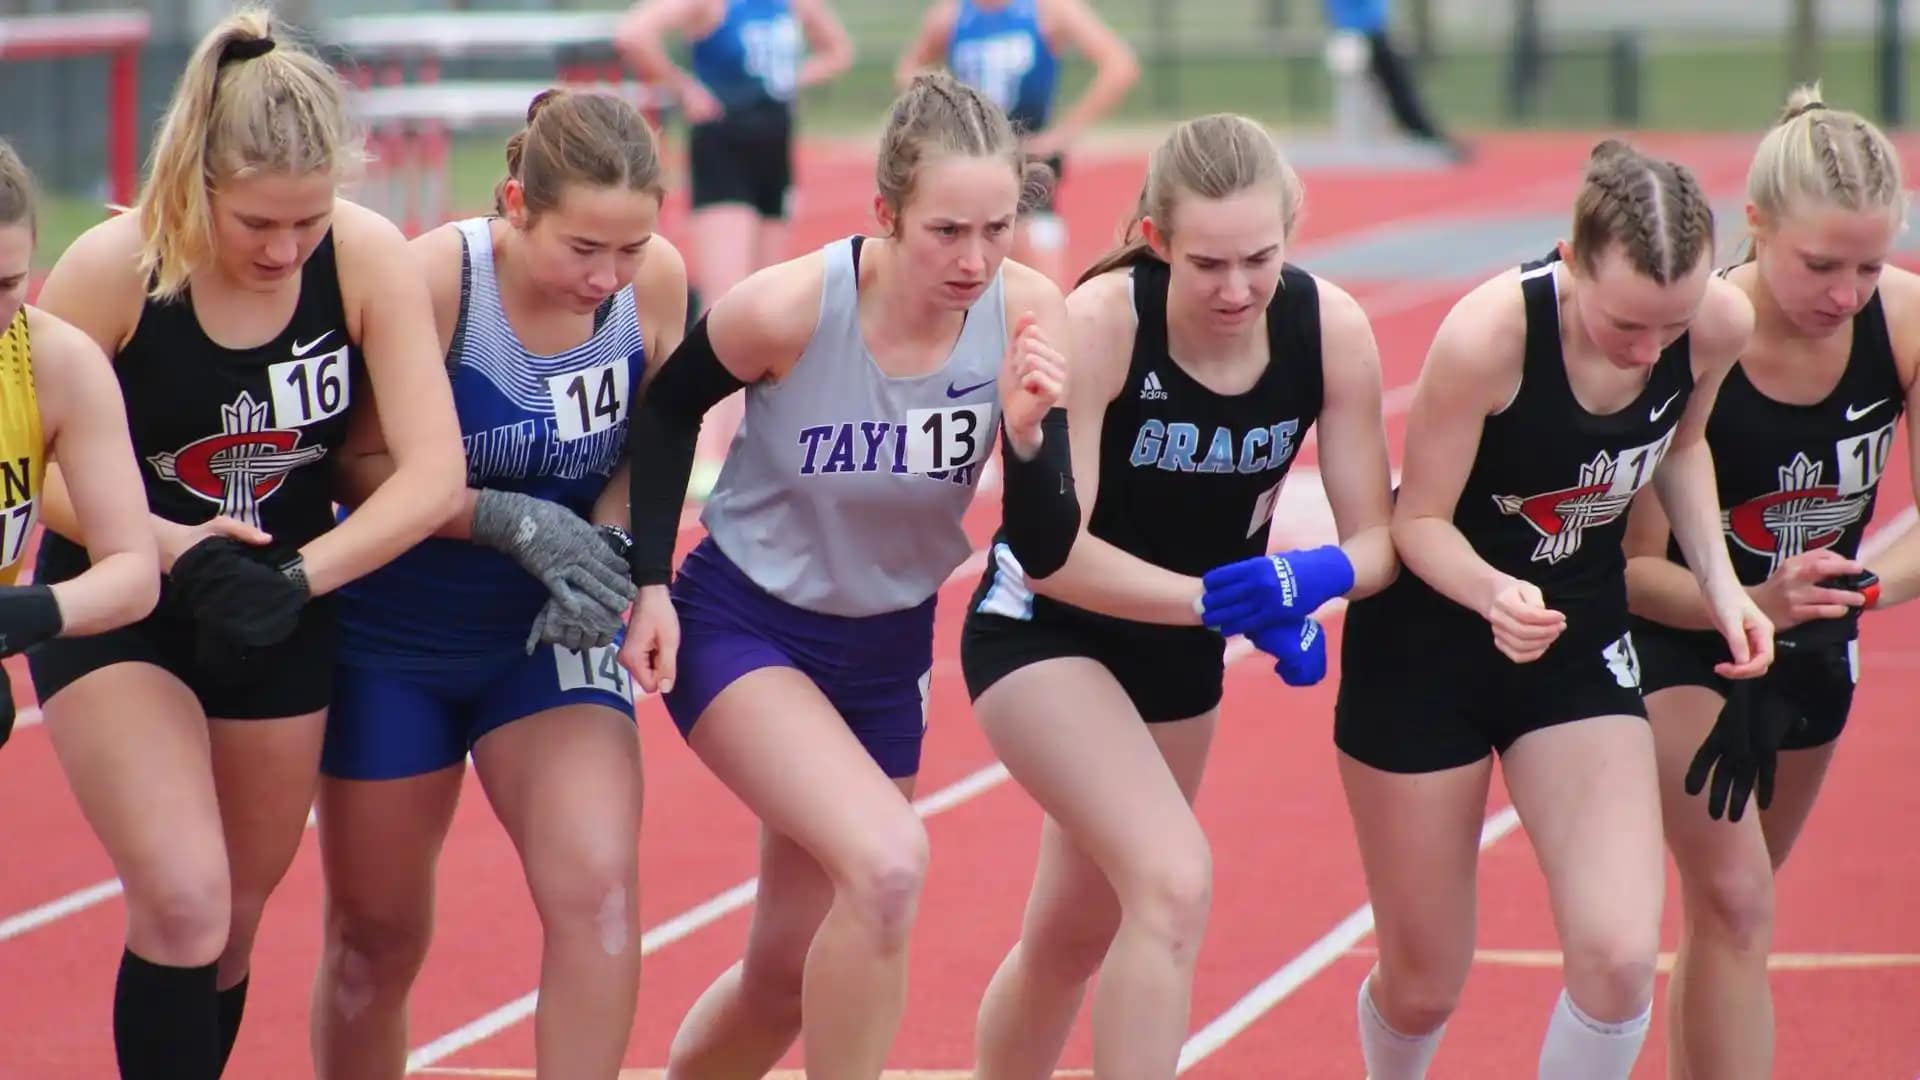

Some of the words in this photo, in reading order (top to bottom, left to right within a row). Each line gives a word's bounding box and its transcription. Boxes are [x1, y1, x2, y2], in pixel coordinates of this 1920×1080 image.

[286, 355, 341, 420] 16
[566, 367, 620, 433] 14
[462, 419, 536, 483] AINT
[797, 420, 977, 487] TAYL
[922, 410, 977, 469] 13
[1129, 416, 1300, 474] GRACE
[1852, 426, 1893, 487] 10
